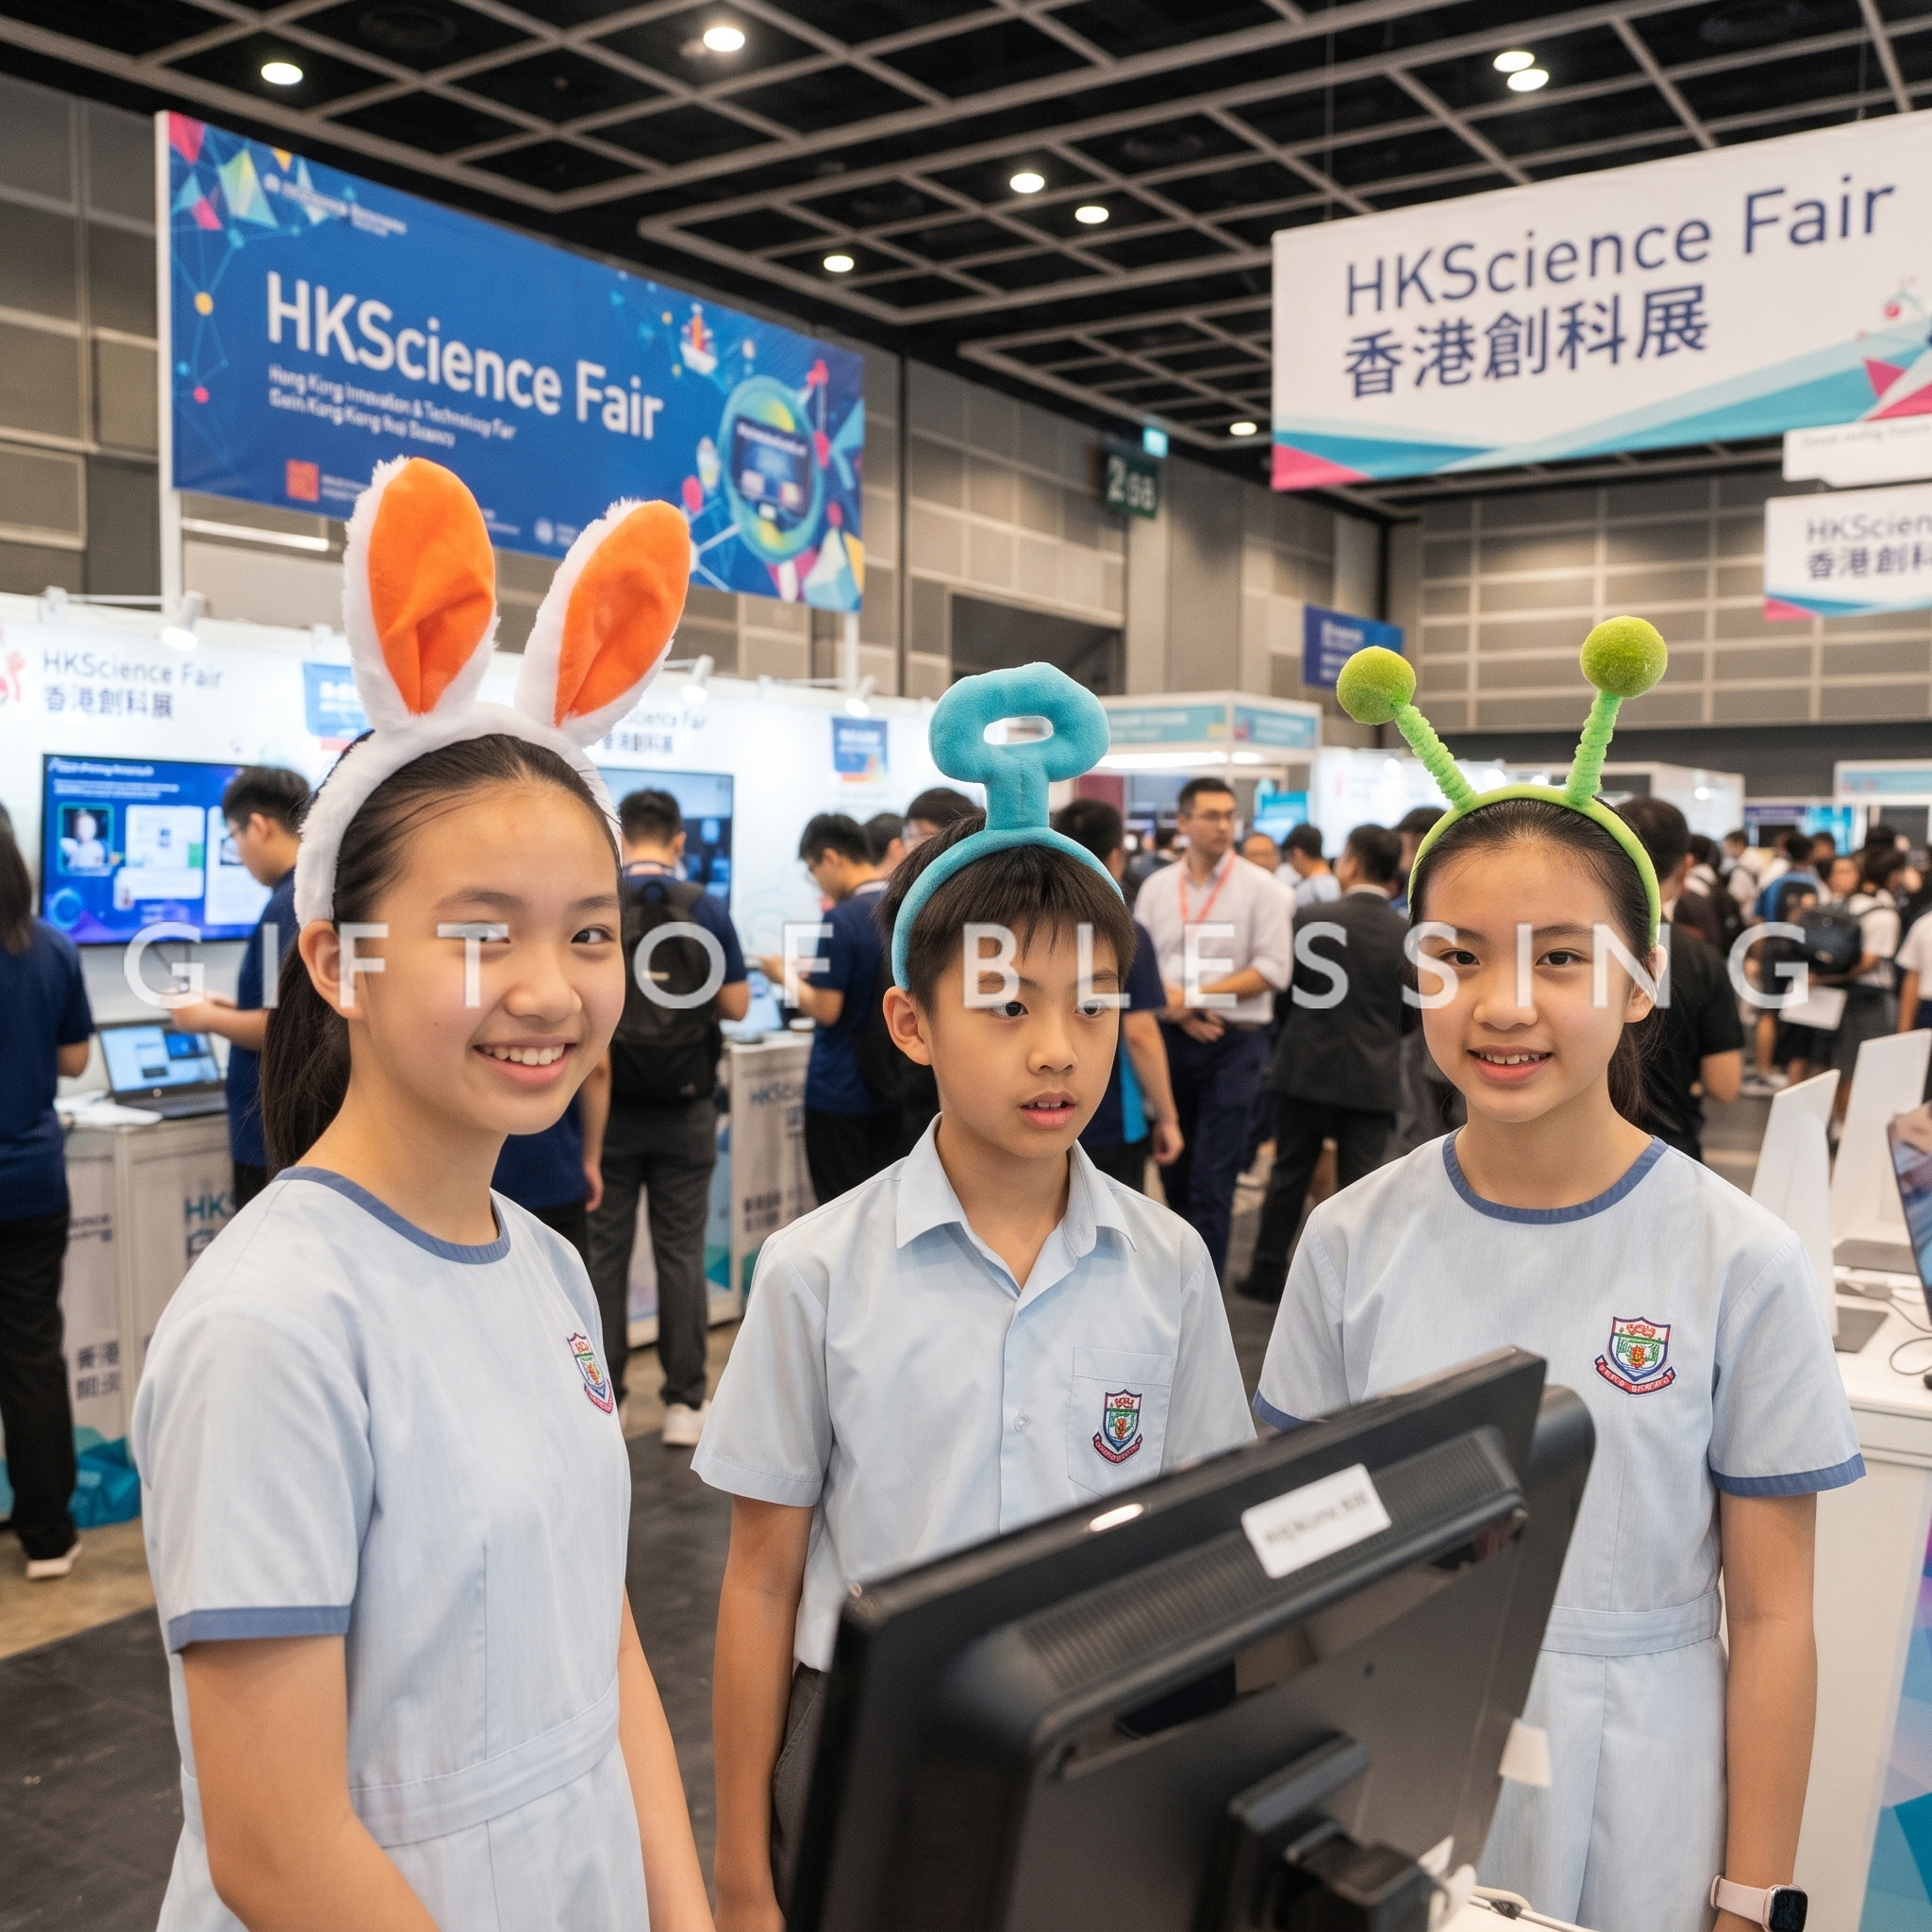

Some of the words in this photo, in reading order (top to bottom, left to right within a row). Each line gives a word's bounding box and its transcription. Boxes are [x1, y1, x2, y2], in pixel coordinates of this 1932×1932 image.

[1347, 214, 1713, 318] HKScience
[1743, 173, 1897, 256] Fair
[267, 271, 562, 416] HKScience
[575, 358, 664, 441] Fair
[1343, 284, 1709, 400] 香港創科展
[43, 650, 173, 684] HKScience
[182, 661, 225, 688] Fair
